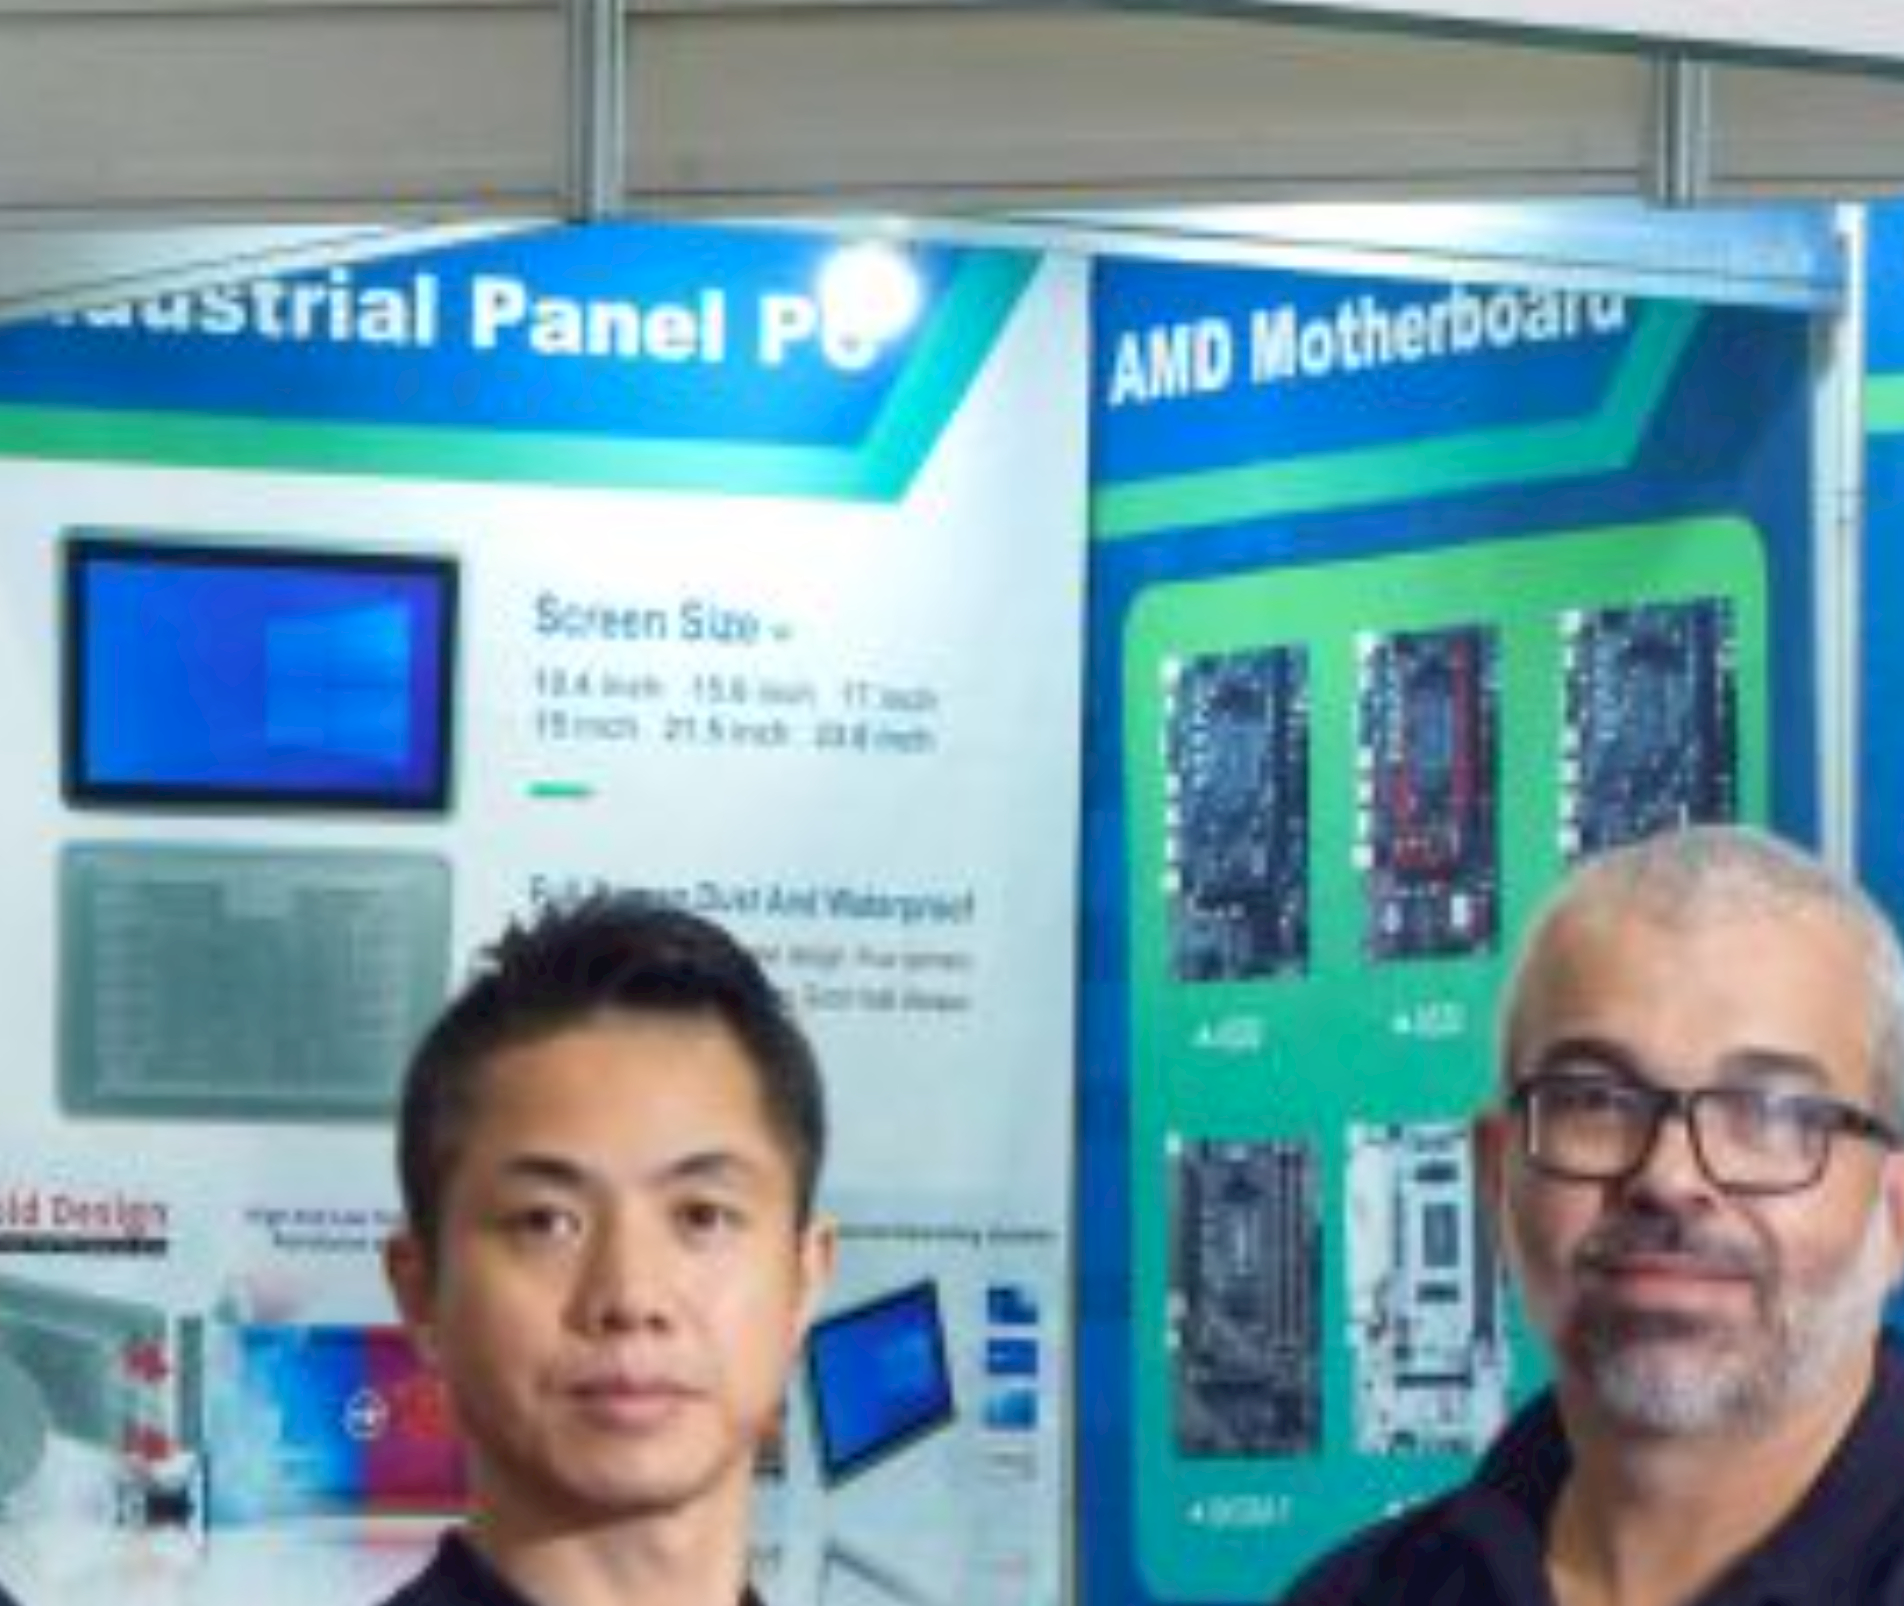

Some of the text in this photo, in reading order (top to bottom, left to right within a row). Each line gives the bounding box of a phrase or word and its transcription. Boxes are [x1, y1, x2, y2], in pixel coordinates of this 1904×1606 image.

[52, 266, 439, 348] ustrial
[471, 276, 725, 364] Panel
[1108, 318, 1233, 408] AMD
[533, 592, 762, 644] Screen Size
